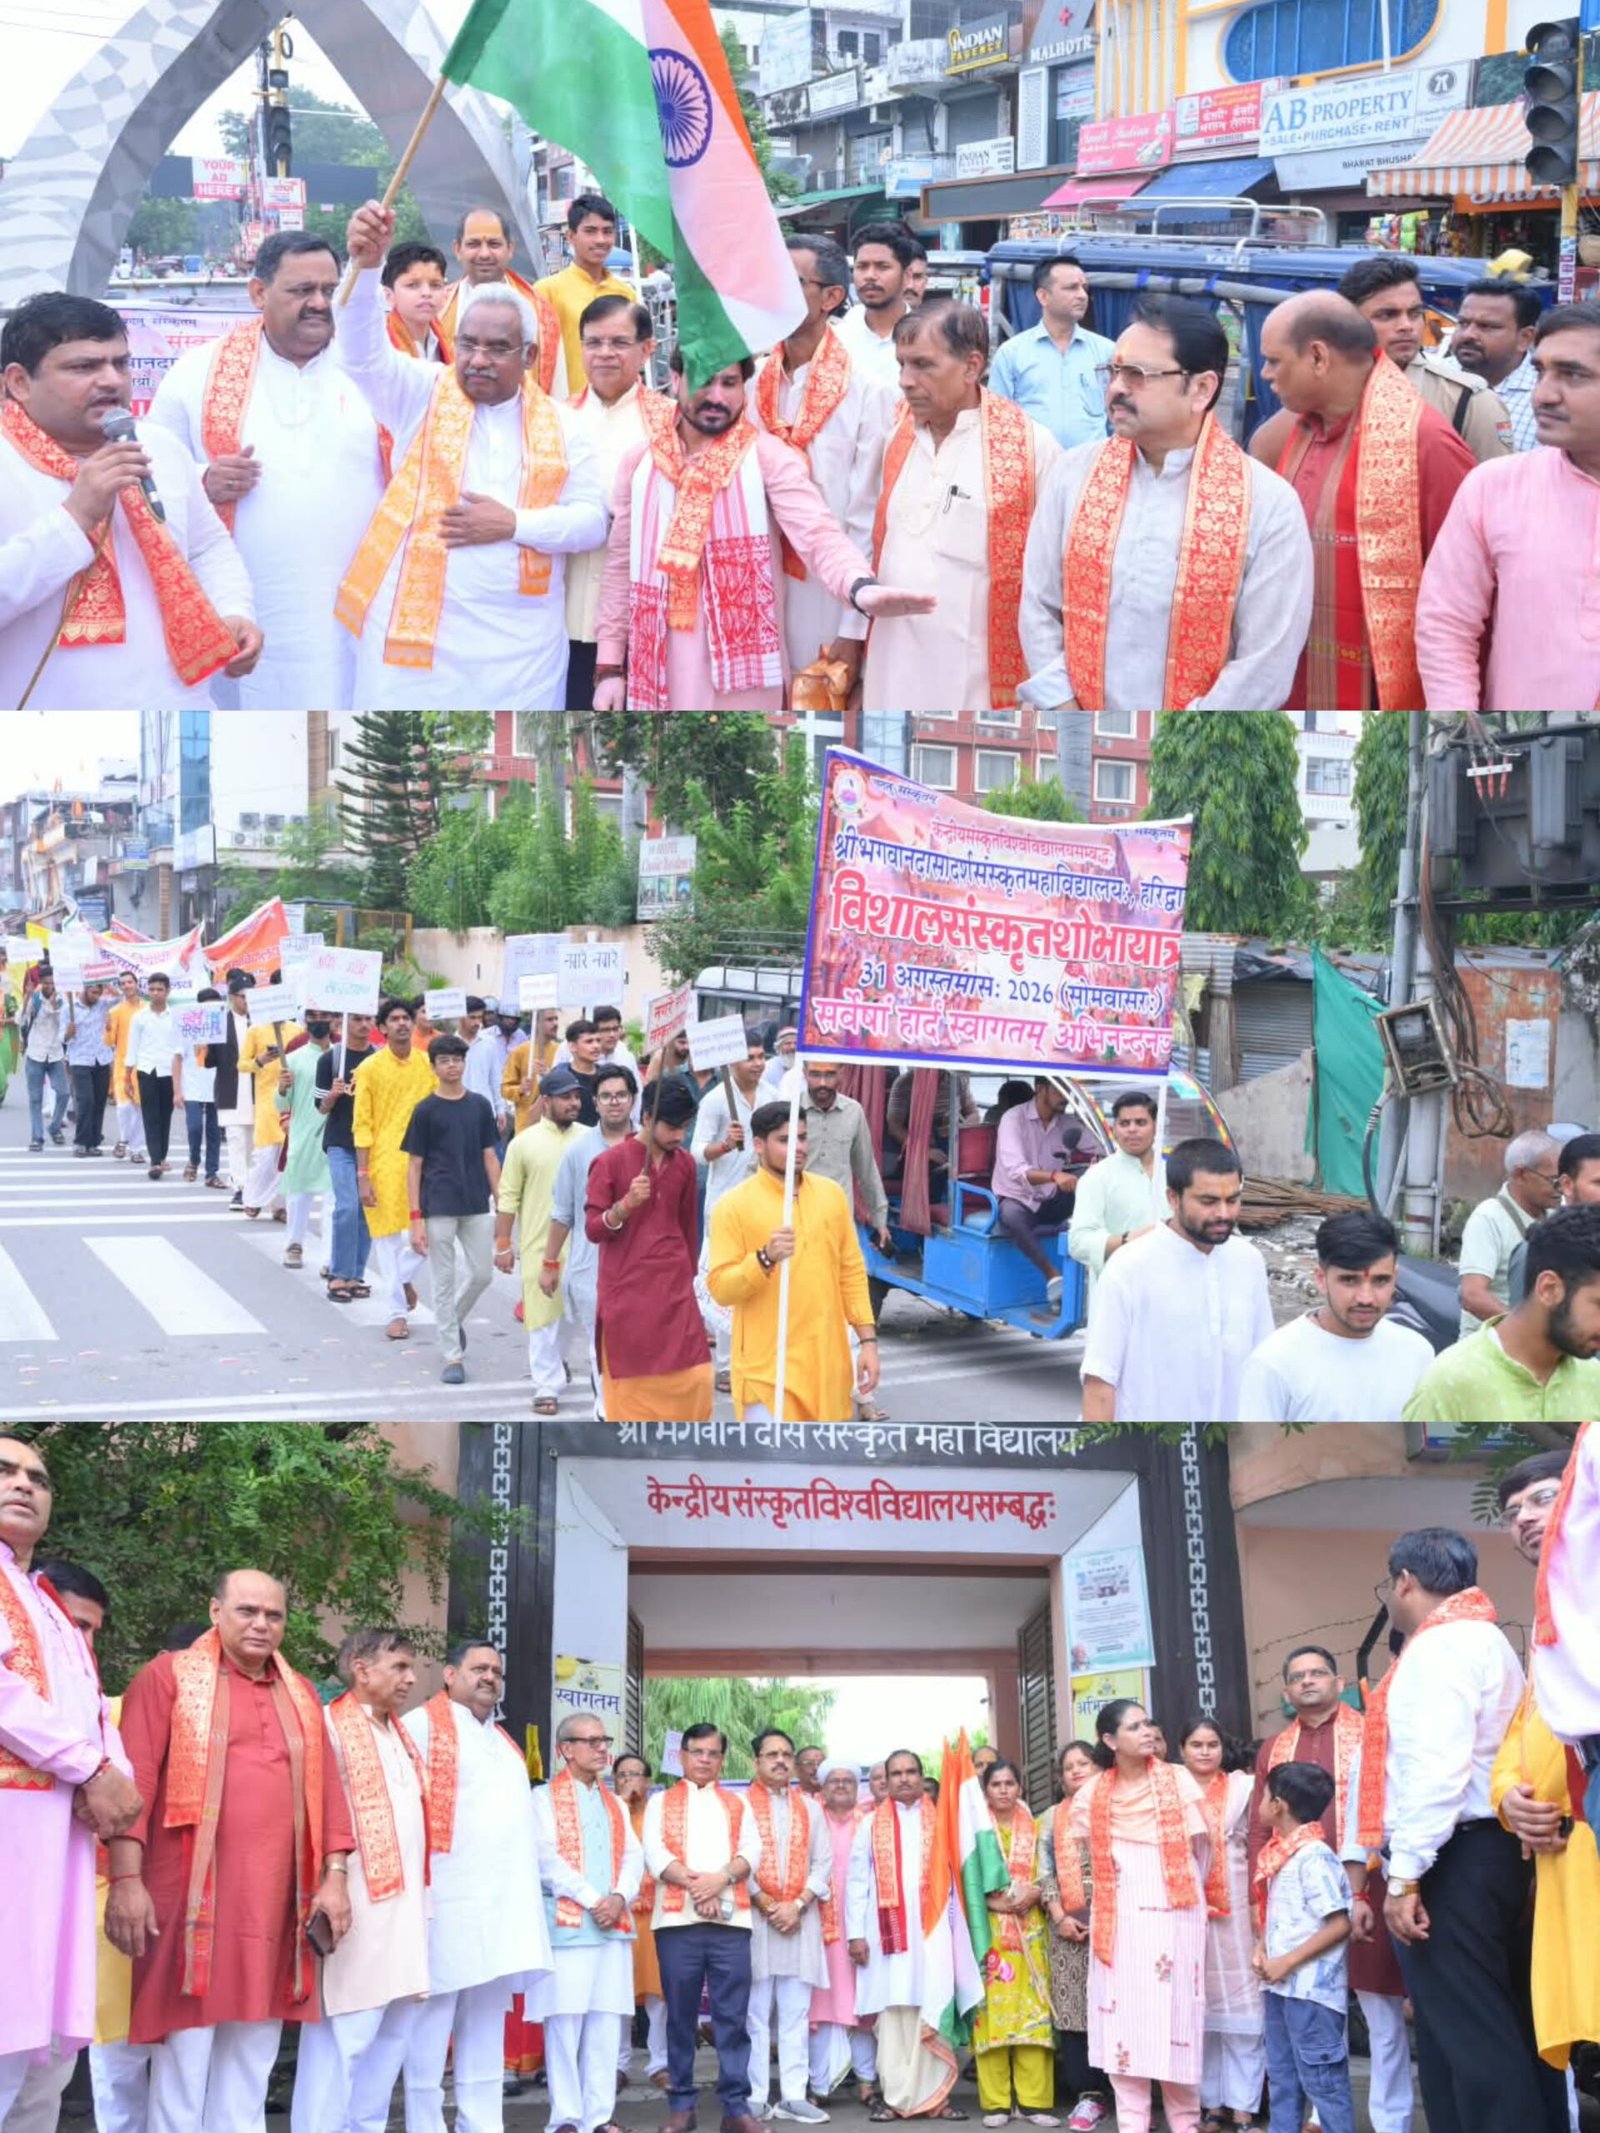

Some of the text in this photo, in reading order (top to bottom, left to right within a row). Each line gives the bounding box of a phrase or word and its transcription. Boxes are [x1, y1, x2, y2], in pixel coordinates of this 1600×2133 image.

[953, 24, 1003, 52] INDIAN
[1030, 34, 1093, 63] MALHOTR
[1264, 98, 1307, 133] AB
[1312, 90, 1412, 123] PROPERTY
[1374, 117, 1409, 133] RENT
[203, 160, 236, 171] YOUR
[1342, 153, 1417, 170] BHARAT BHUSHA
[211, 172, 228, 183] AD
[1140, 876, 1186, 911] हरिद्वा
[832, 869, 1182, 972] विशालसंस्कृतशोभायात्र
[860, 962, 886, 986] 31
[1008, 979, 1054, 1004] 2026
[950, 1013, 1047, 1052] स्वागतम्
[754, 1422, 805, 1449] दास
[914, 1423, 963, 1456] महा
[555, 1687, 622, 1715] स्वागतम्
